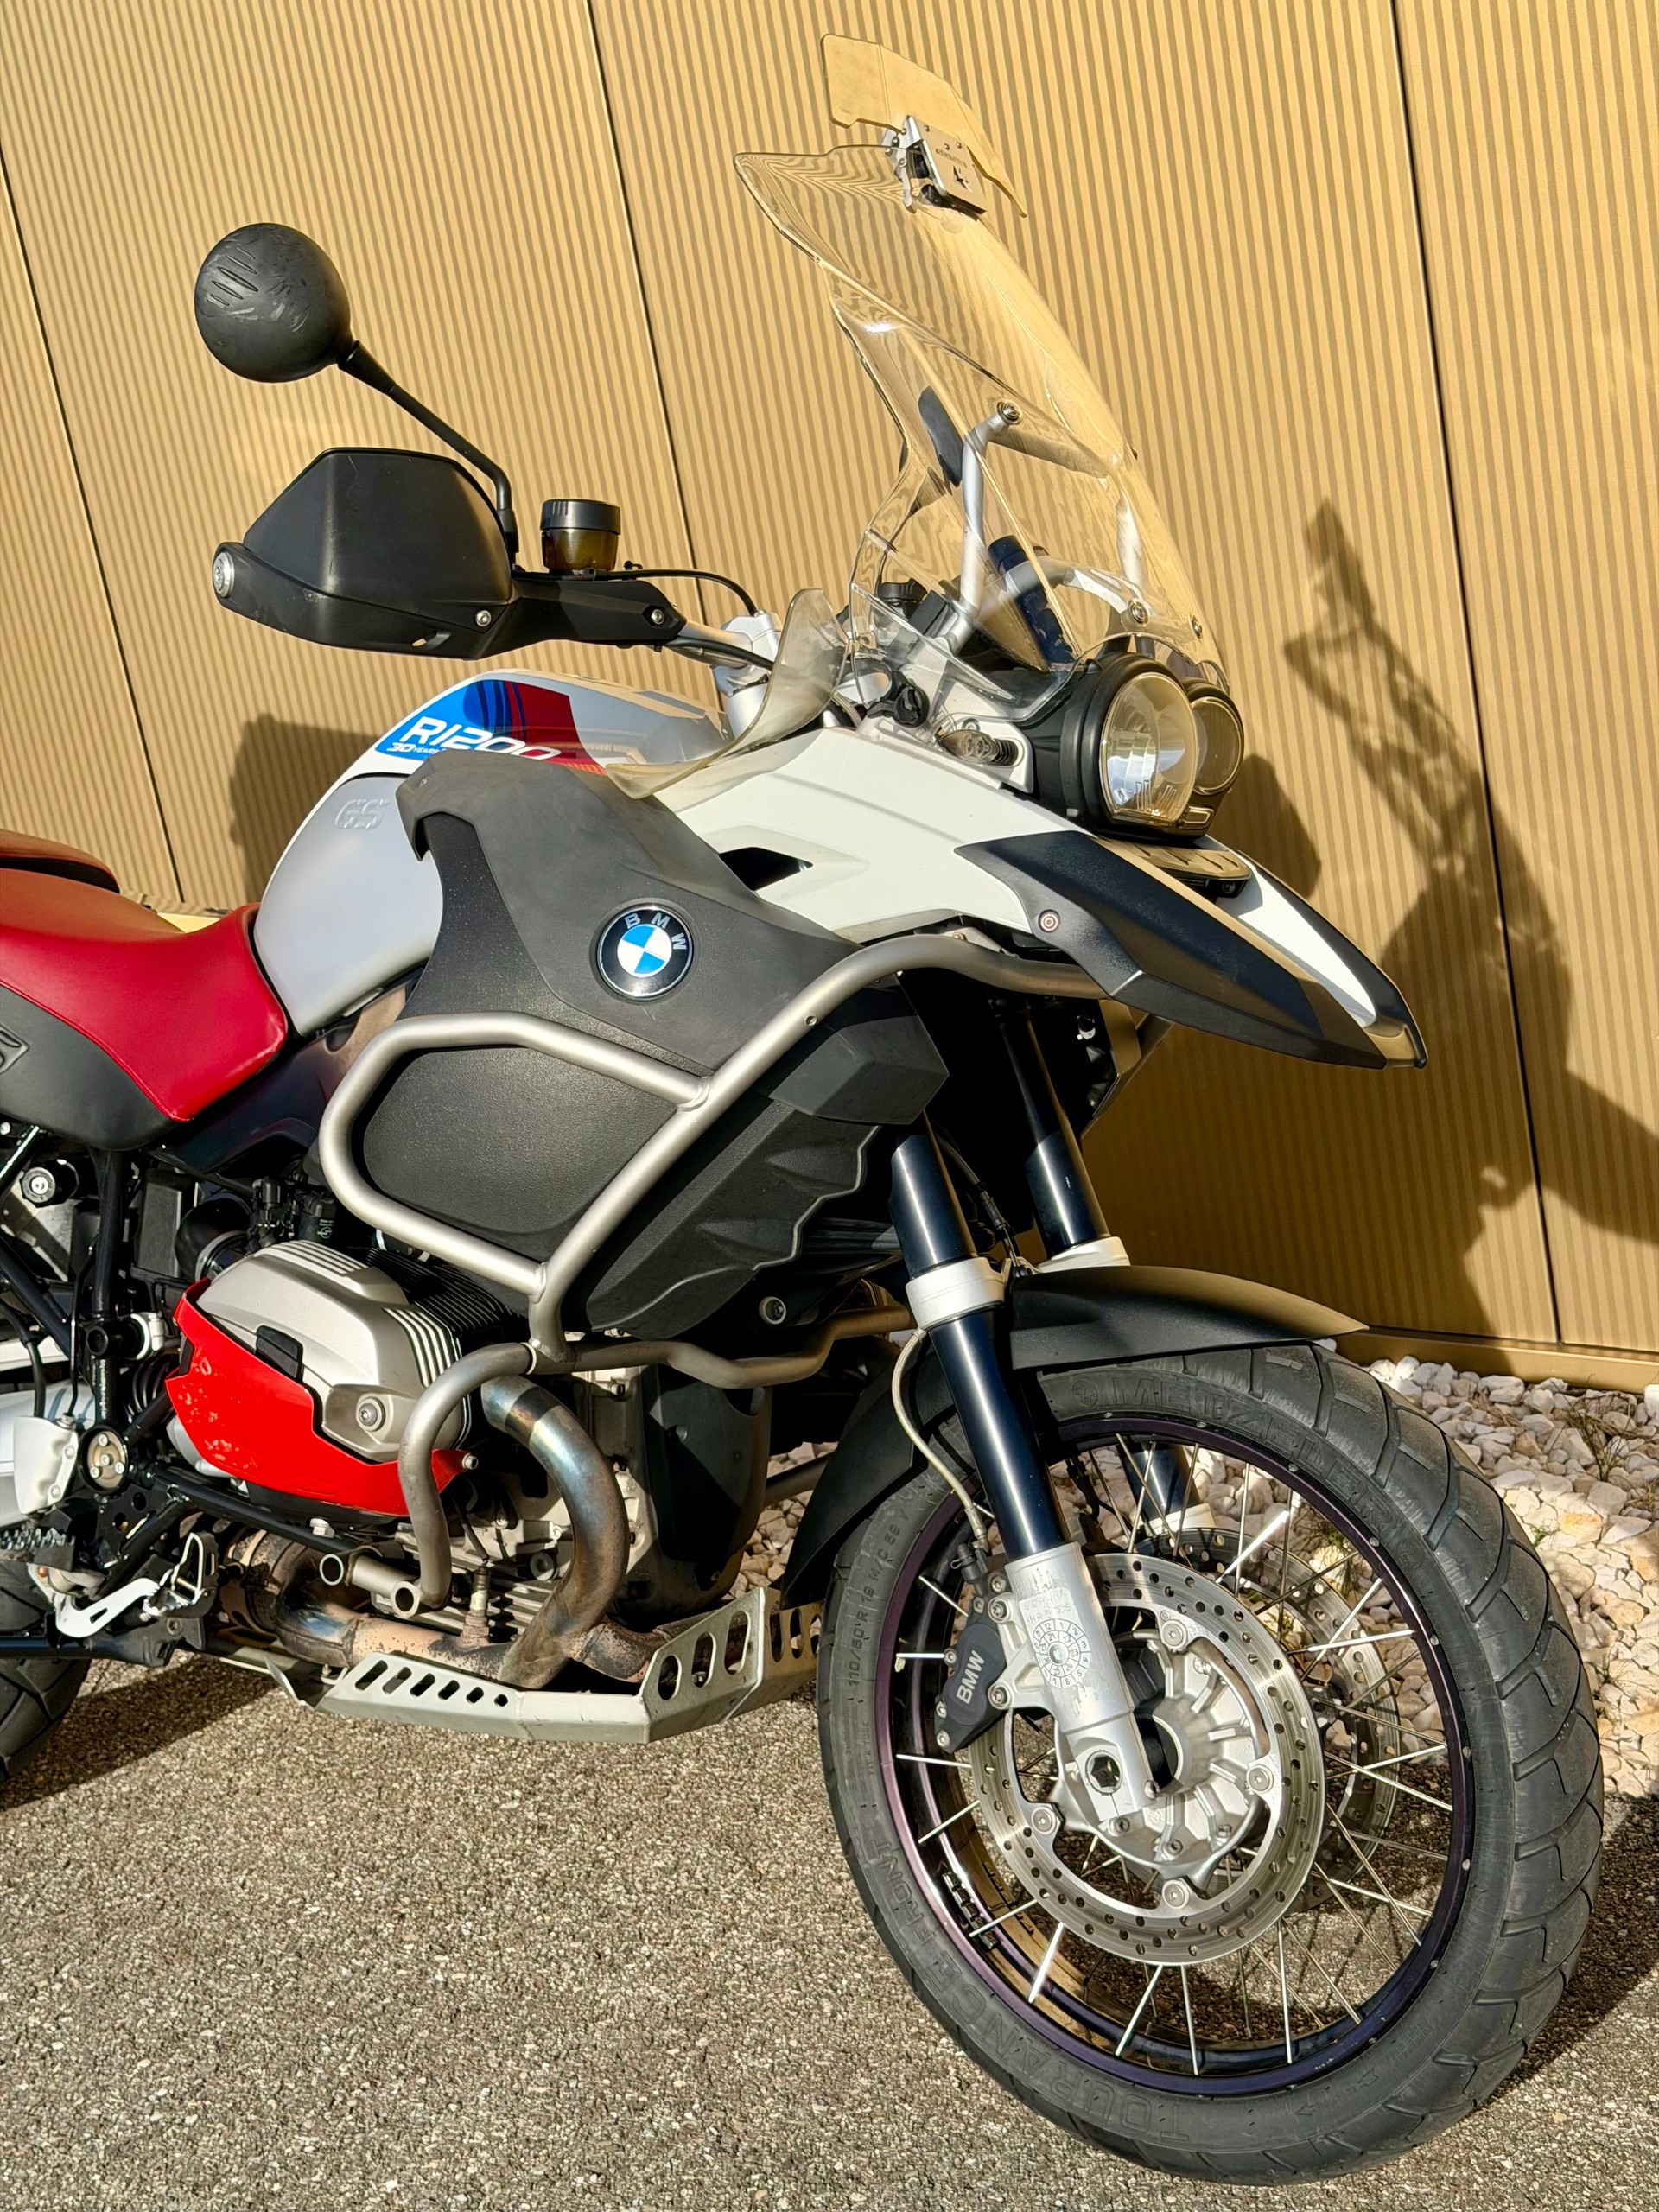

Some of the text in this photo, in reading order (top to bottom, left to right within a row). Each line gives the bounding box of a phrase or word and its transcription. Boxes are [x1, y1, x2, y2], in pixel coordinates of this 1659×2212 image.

[386, 741, 416, 753] 30
[400, 716, 562, 760] R1200
[334, 798, 391, 830] GS
[624, 912, 688, 950] BMW
[1072, 1627, 1078, 1636] 2
[1071, 1648, 1079, 1657] 23
[1081, 1640, 1087, 1649] 3
[955, 1649, 985, 1705] BMW
[1076, 1669, 1083, 1678] 5
[870, 1839, 1190, 2143] TOURANCE FRONT
